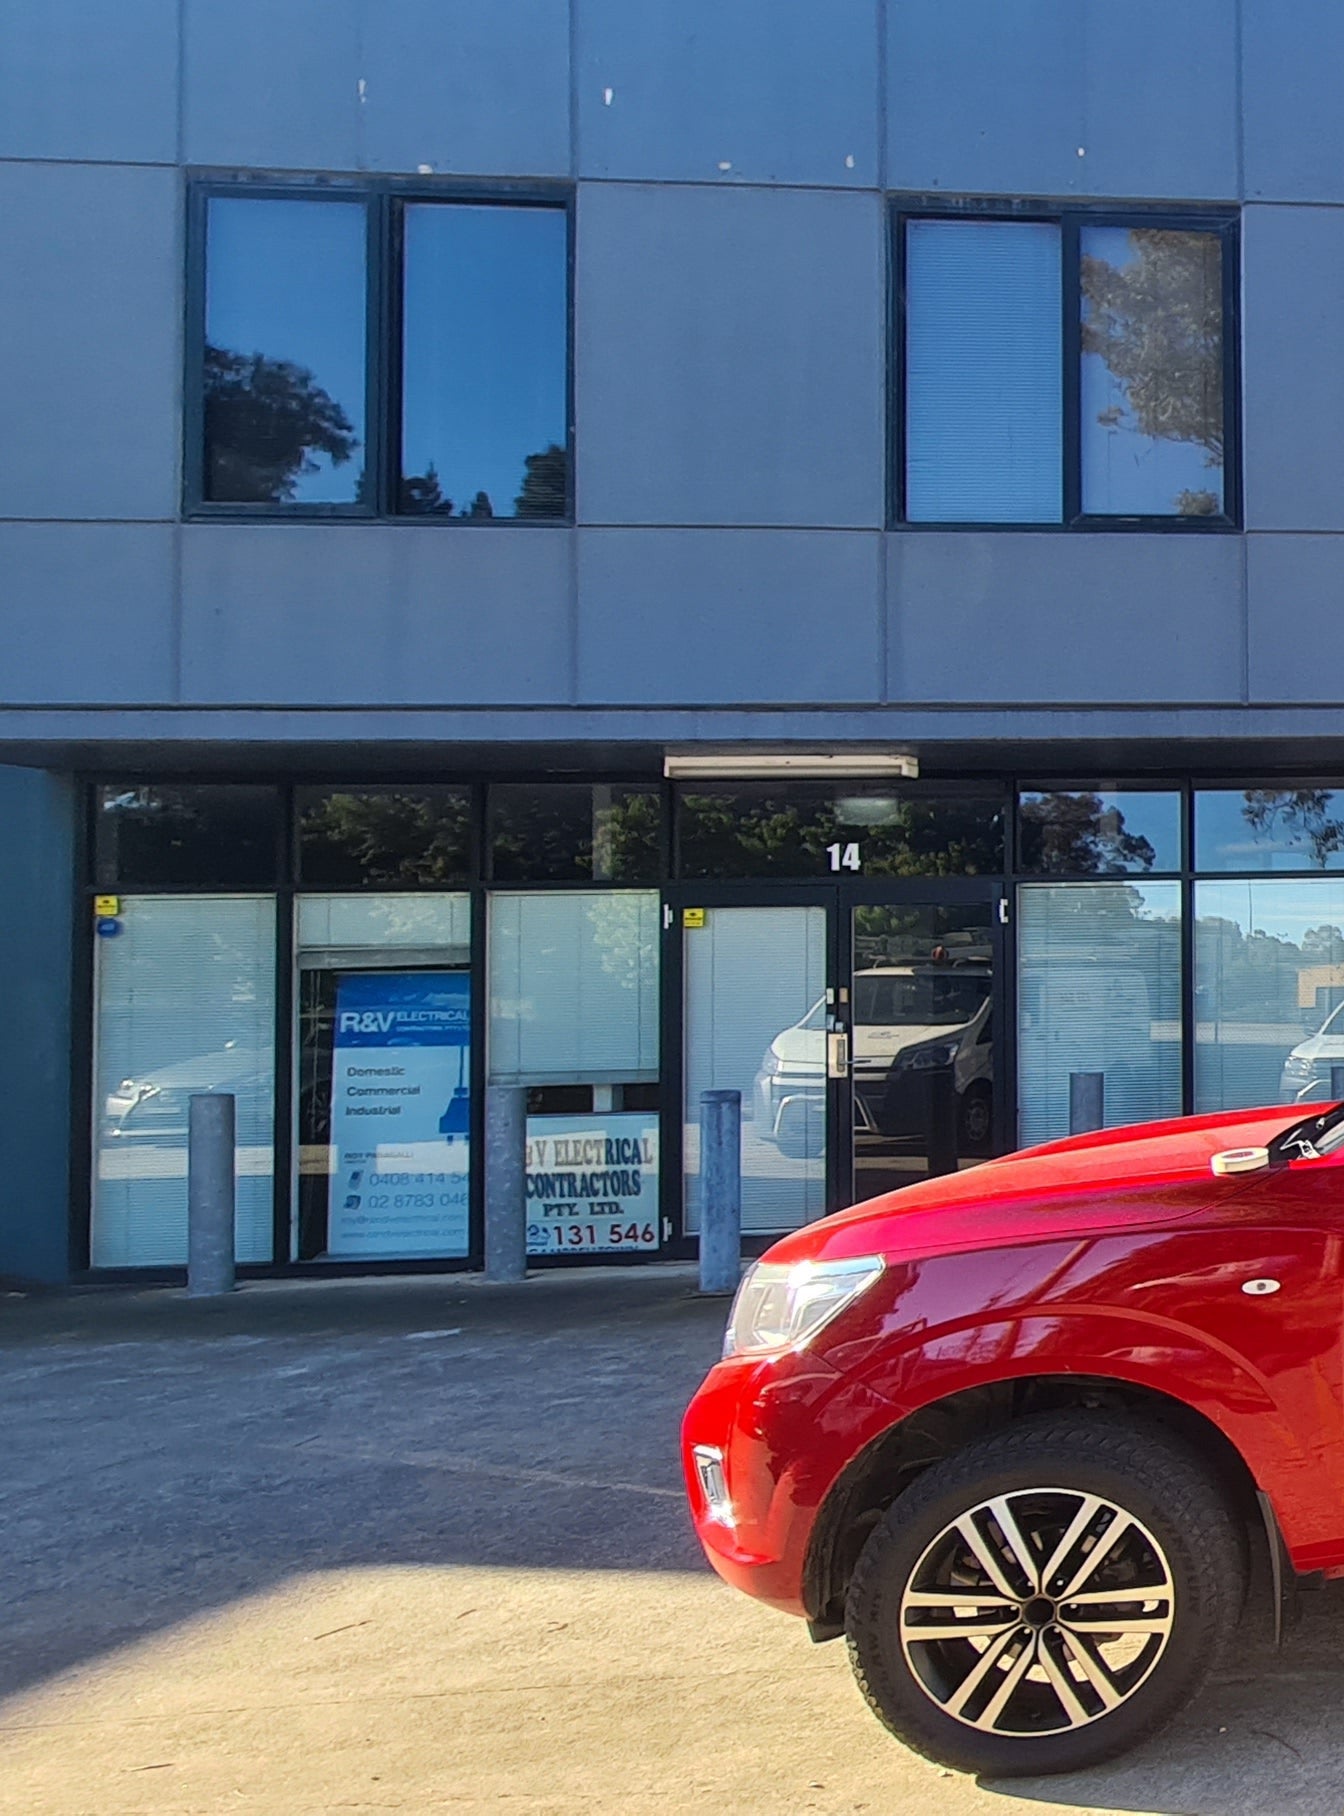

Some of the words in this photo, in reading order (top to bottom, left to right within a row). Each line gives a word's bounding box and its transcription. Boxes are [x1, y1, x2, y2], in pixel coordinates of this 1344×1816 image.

[826, 843, 861, 871] 14
[340, 1011, 395, 1033] R&V
[396, 1010, 468, 1022] ELECTRICAL
[346, 1066, 406, 1077] Domestic
[346, 1086, 420, 1097] Commercial
[345, 1106, 402, 1116] Industrial
[554, 1137, 654, 1167] ELECTRICAL
[526, 1169, 642, 1199] CONTRACTORS
[554, 1224, 596, 1245] 131
[609, 1223, 656, 1244] 546
